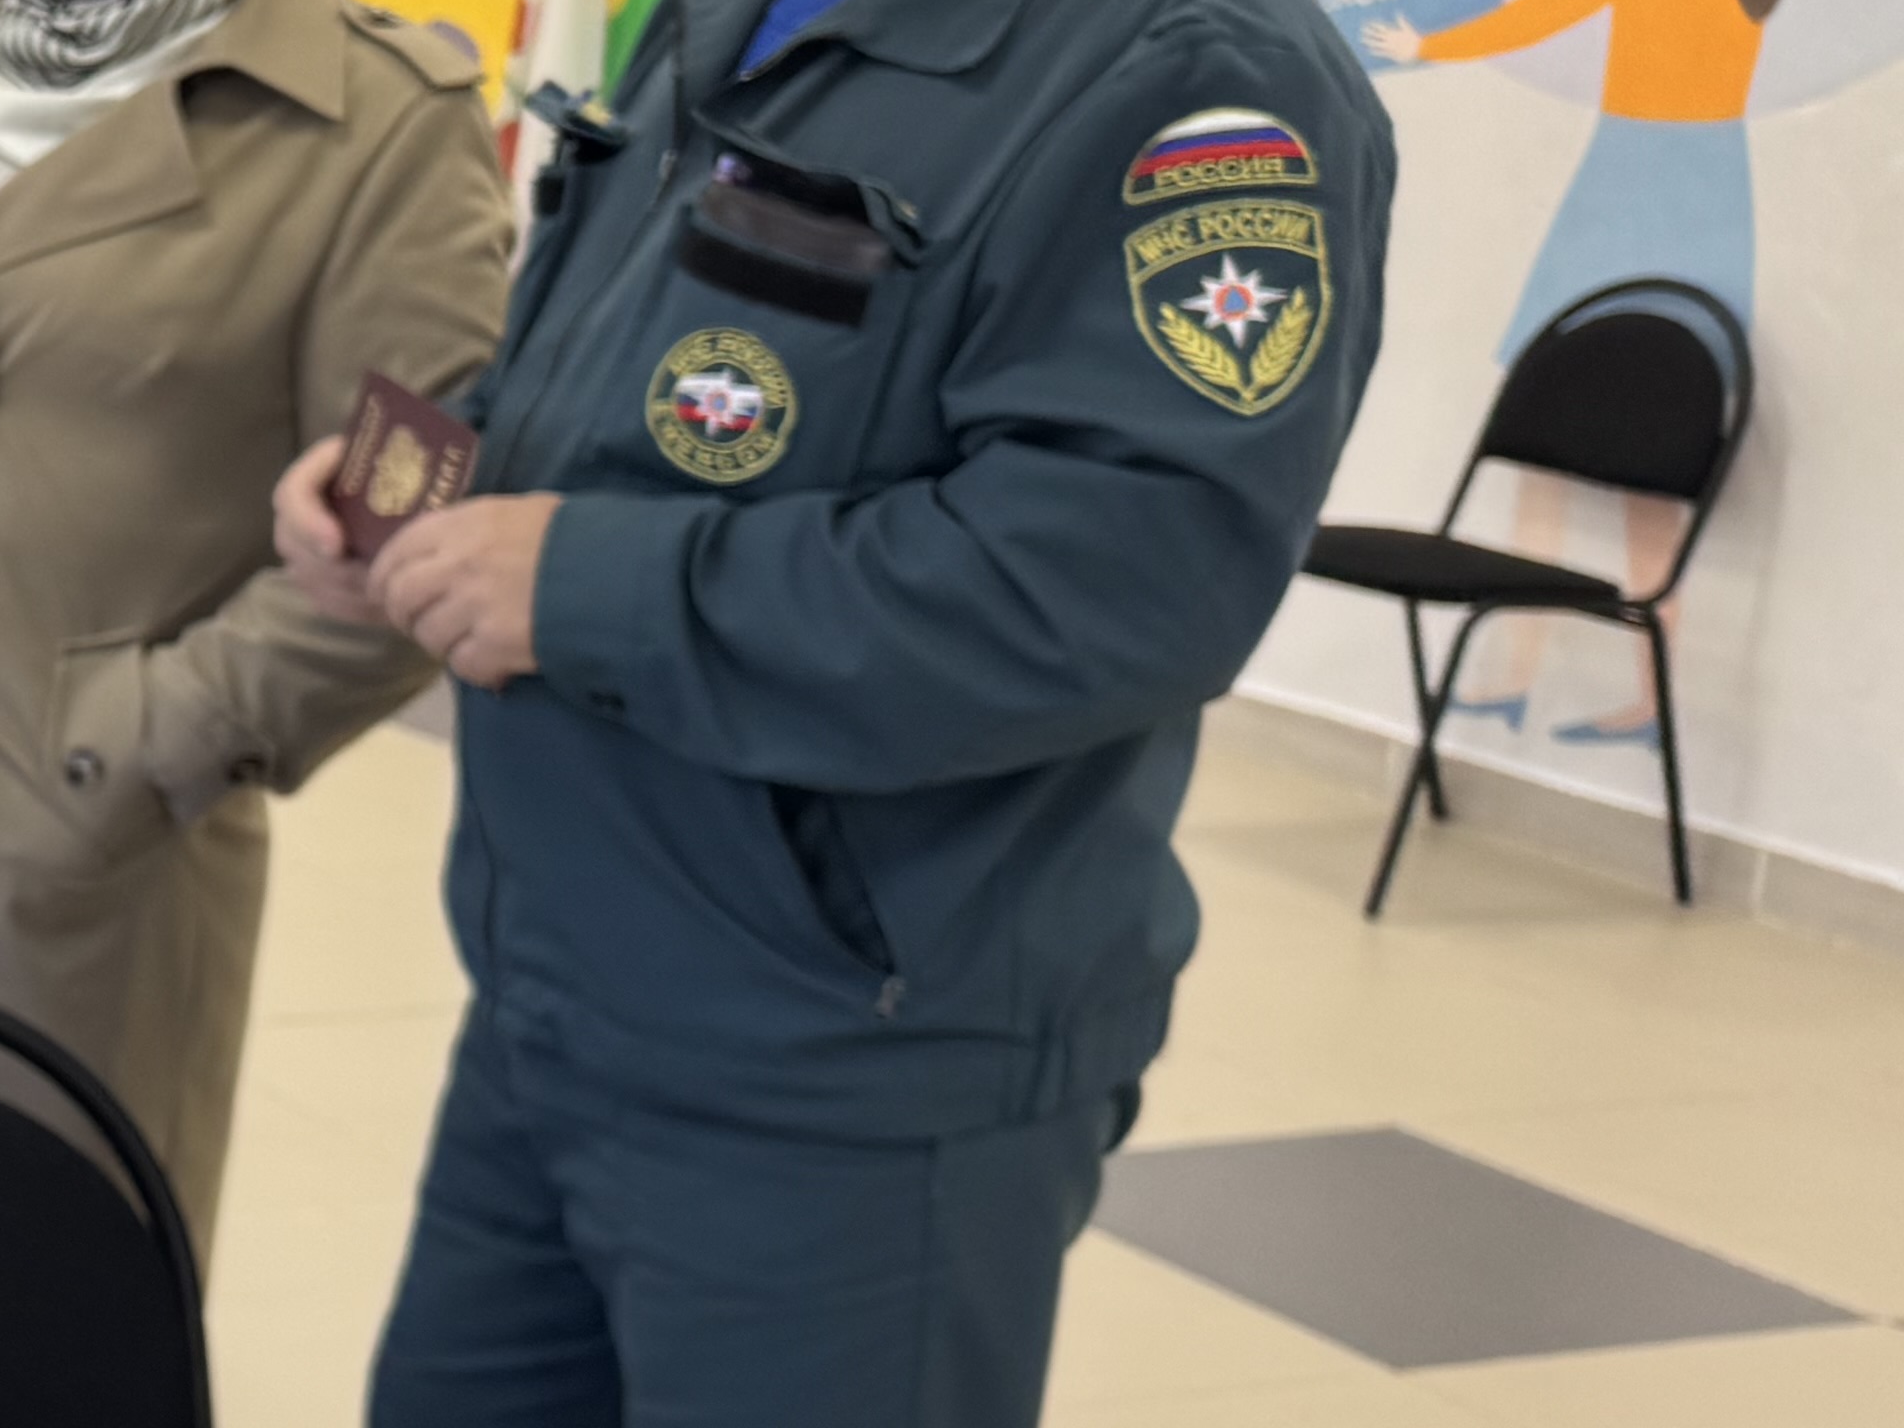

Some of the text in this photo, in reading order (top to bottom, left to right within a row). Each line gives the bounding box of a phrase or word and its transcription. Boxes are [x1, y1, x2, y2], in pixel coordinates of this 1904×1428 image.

[1154, 153, 1283, 187] РОССИЯ
[1136, 209, 1311, 264] МЧС РОССИИ
